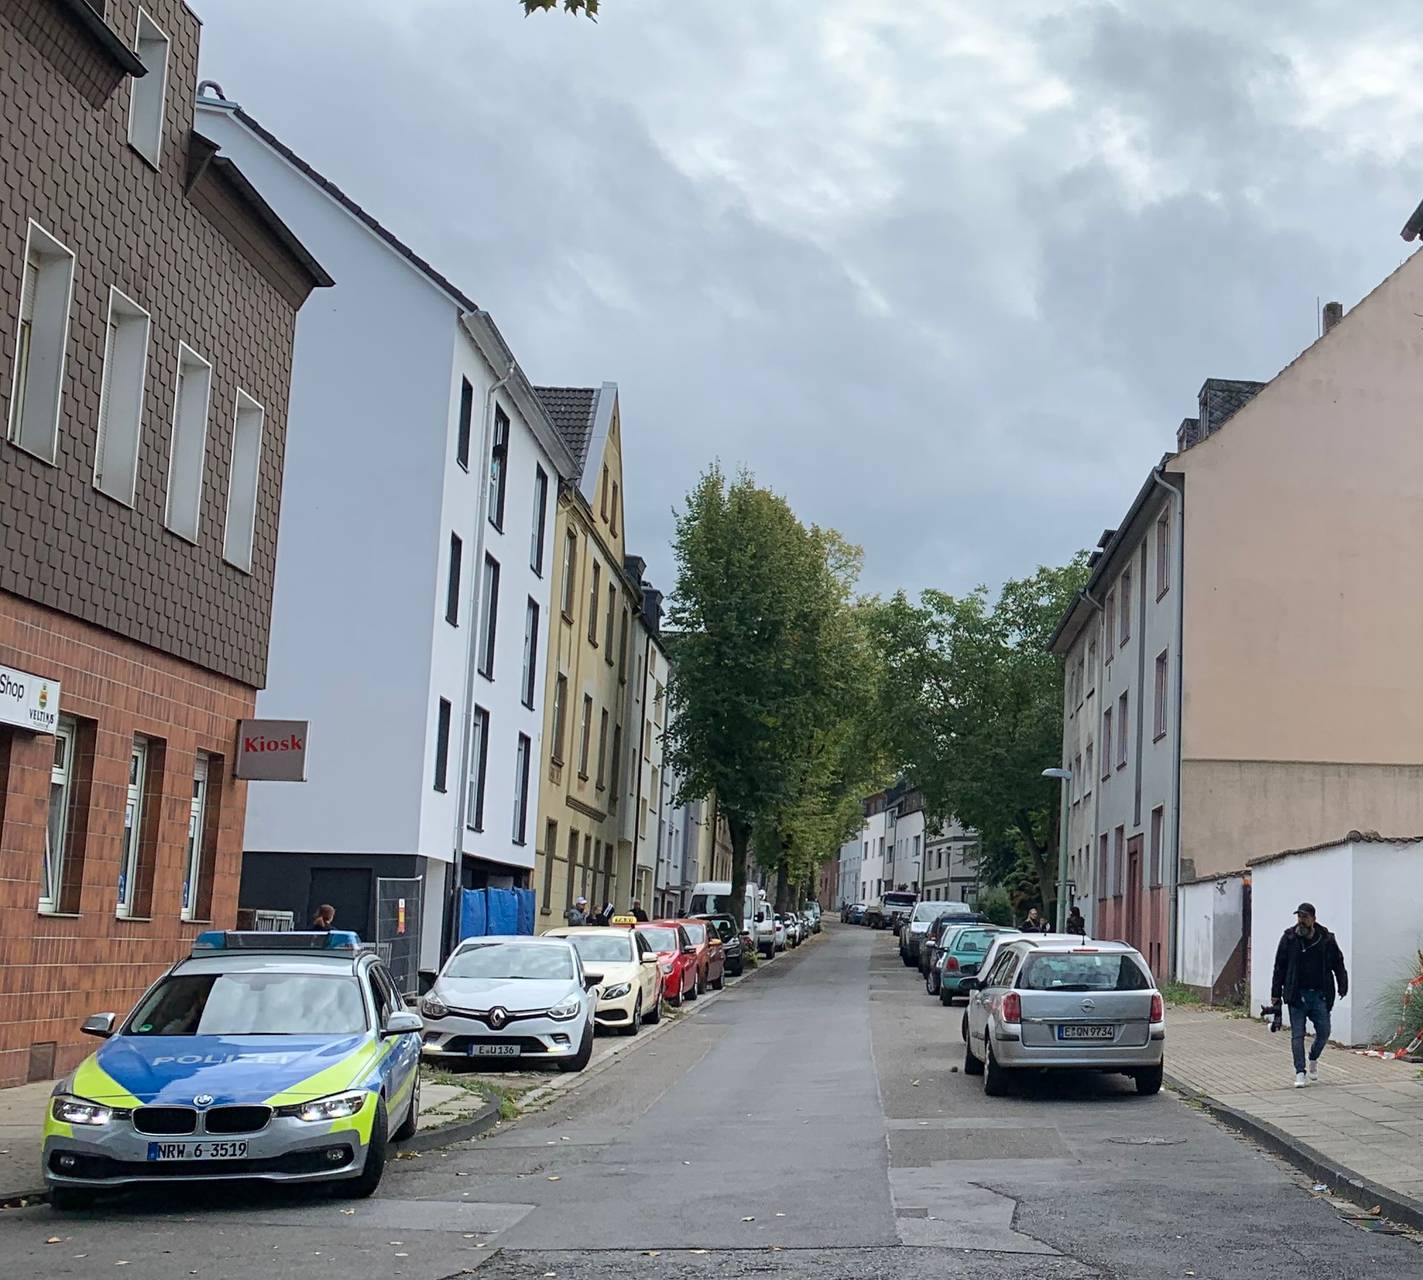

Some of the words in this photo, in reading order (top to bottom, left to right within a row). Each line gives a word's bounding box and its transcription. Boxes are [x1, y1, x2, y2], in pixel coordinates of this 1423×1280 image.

[0, 673, 25, 702] Shop
[29, 708, 55, 725] VELTINS
[244, 734, 302, 753] Kiosk
[152, 1053, 289, 1066] POLIZEI
[158, 1143, 186, 1159] NRW
